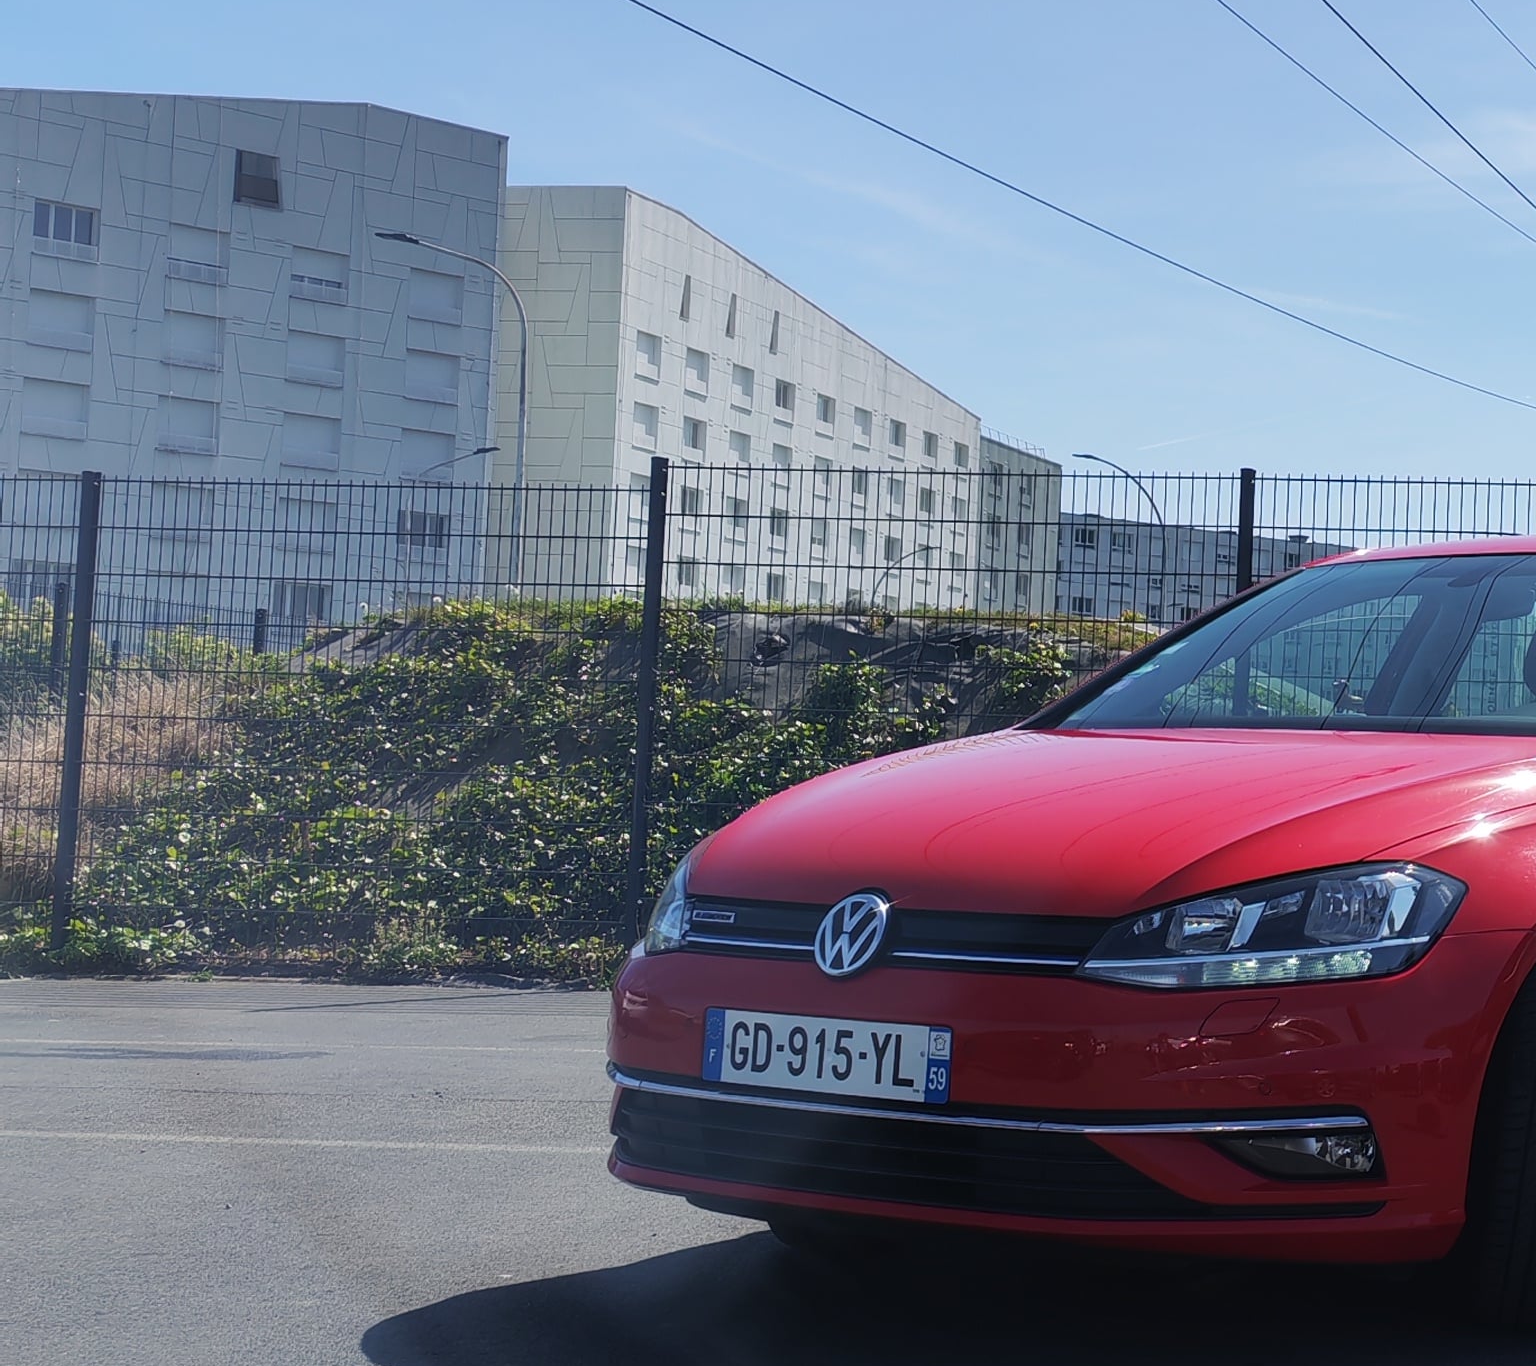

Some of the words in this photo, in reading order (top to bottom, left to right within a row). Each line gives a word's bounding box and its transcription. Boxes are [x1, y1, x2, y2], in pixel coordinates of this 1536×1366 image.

[708, 1049, 717, 1065] F
[729, 1020, 915, 1088] GD-915-YL
[928, 1066, 947, 1091] 59
